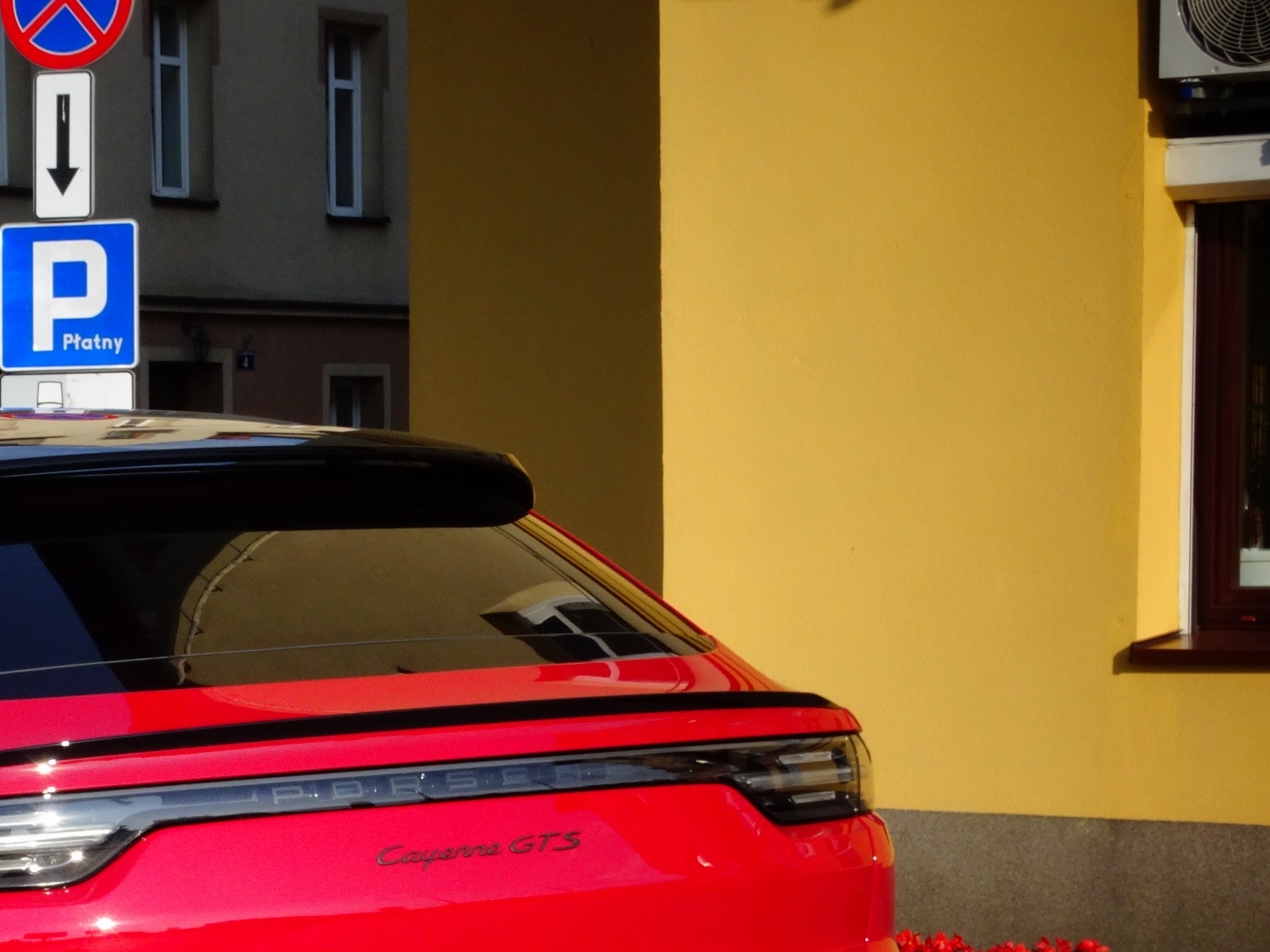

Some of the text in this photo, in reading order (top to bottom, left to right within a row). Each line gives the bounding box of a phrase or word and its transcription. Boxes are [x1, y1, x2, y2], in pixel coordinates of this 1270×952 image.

[33, 239, 107, 352] P
[63, 333, 123, 354] Płatny
[376, 831, 580, 871] Cayenne GTS
